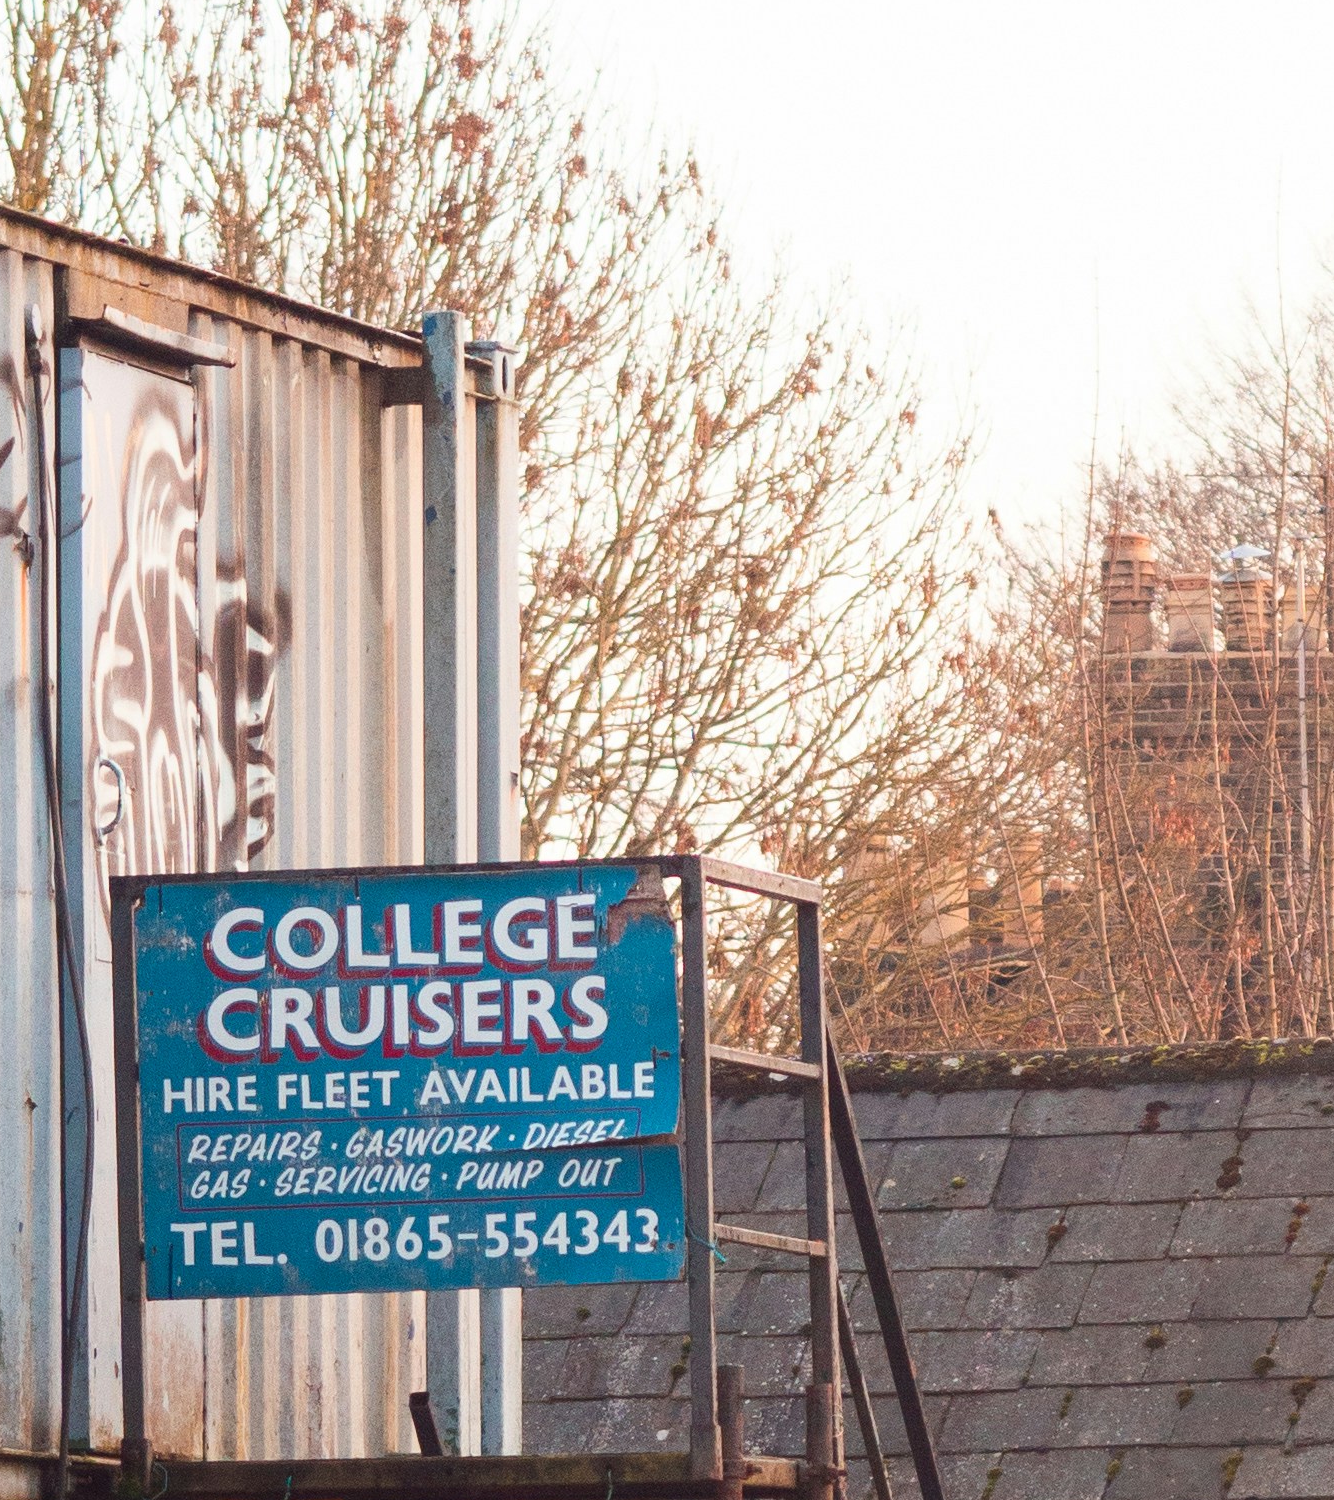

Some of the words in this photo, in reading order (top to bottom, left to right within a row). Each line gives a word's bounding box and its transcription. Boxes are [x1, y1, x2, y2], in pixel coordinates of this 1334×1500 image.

[205, 893, 598, 978] COLLEGE
[200, 975, 609, 1058] CRUISERS
[163, 1075, 258, 1113] HIRE
[278, 1071, 401, 1111] FLEET
[419, 1061, 656, 1107] AVAILABLE
[188, 1130, 322, 1164] REPAIRS
[346, 1124, 501, 1159] GASWORK
[522, 1118, 626, 1151] DIESEL
[190, 1171, 250, 1199] GAS
[274, 1163, 431, 1197] SERVICING
[456, 1161, 545, 1191] PUMP
[559, 1157, 622, 1188] OUT
[170, 1220, 289, 1266] TEL.
[315, 1208, 660, 1263] 01865-554343
